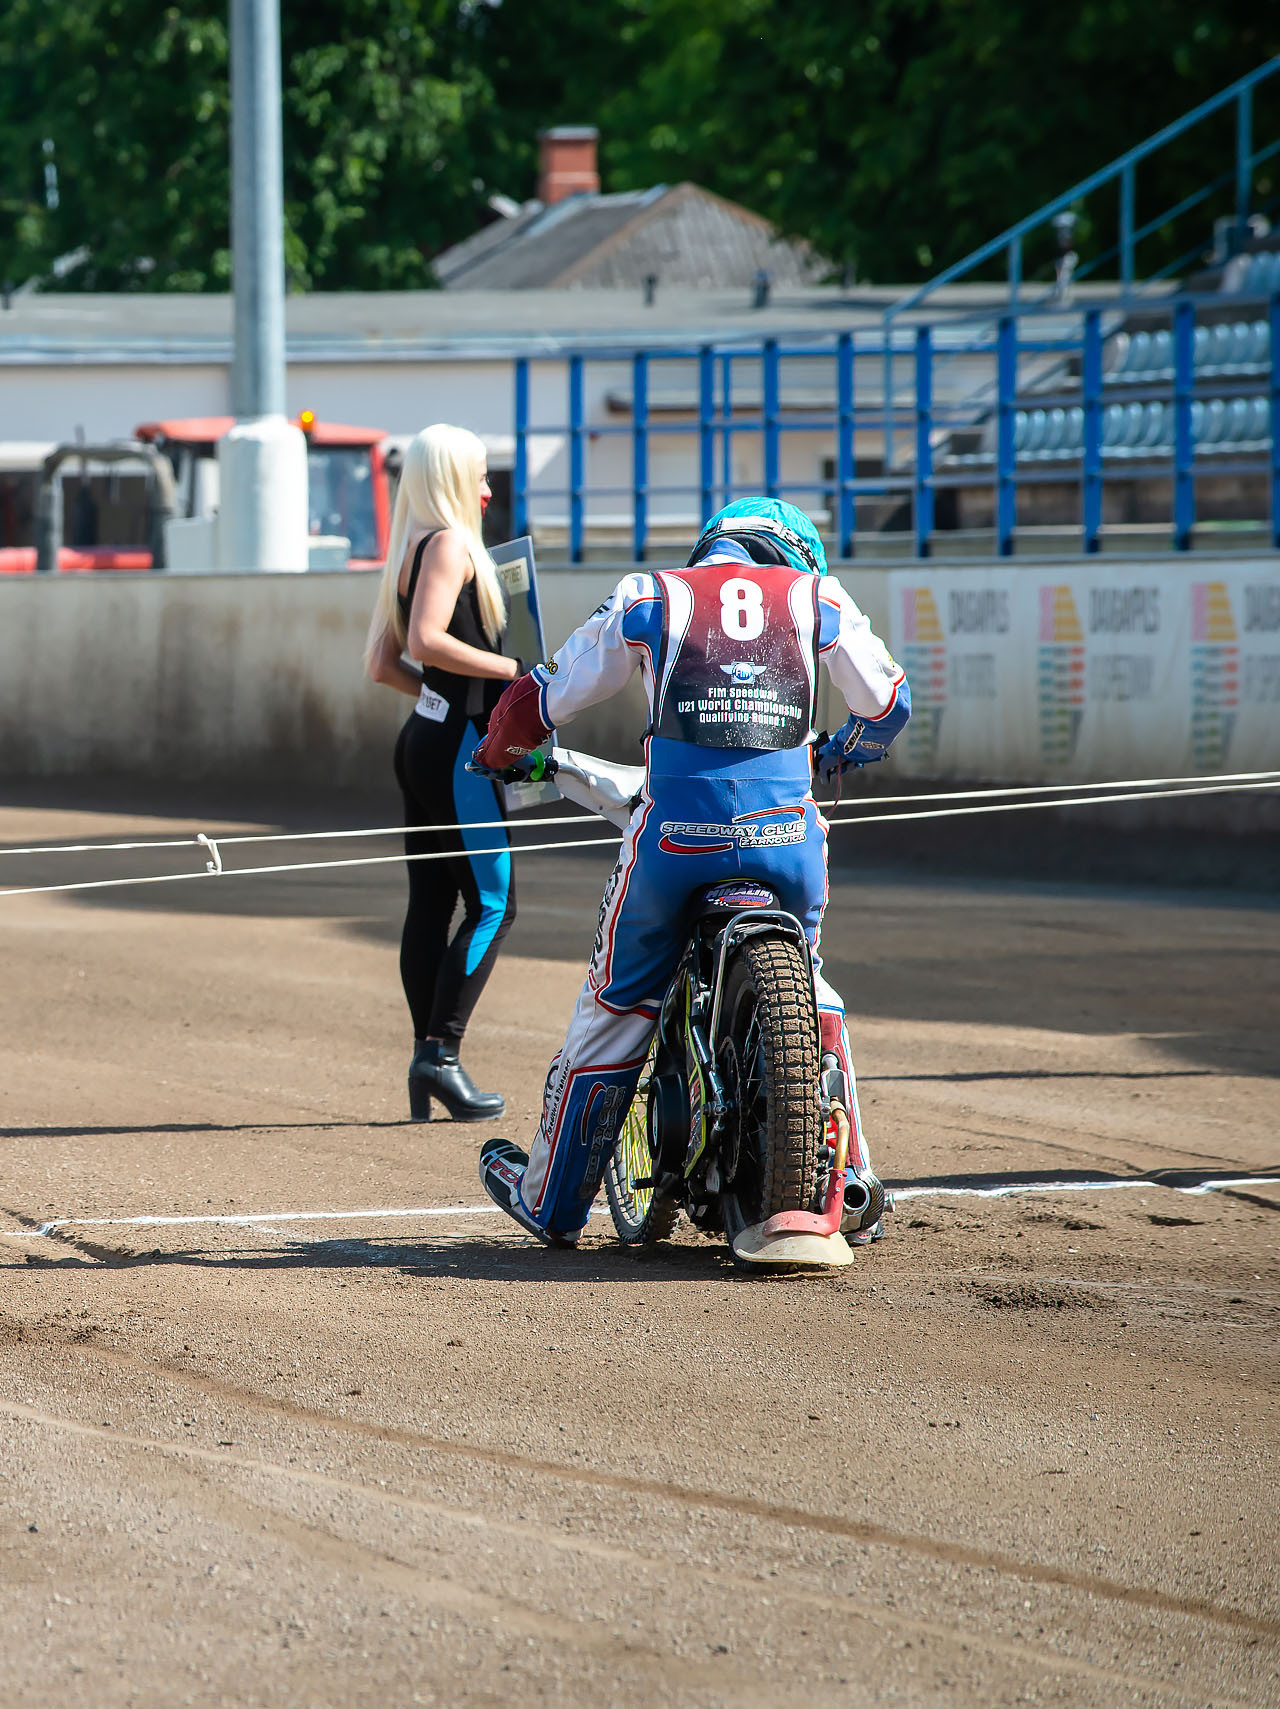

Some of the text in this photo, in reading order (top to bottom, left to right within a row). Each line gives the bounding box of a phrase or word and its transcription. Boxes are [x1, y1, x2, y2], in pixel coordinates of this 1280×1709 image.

[719, 577, 765, 642] 8
[708, 687, 779, 701] FIM Speedway
[677, 699, 803, 720] U21 World Championship
[699, 712, 750, 723] Qualifying
[751, 712, 780, 726] Round
[660, 821, 807, 838] SPEEDWAY CLUB
